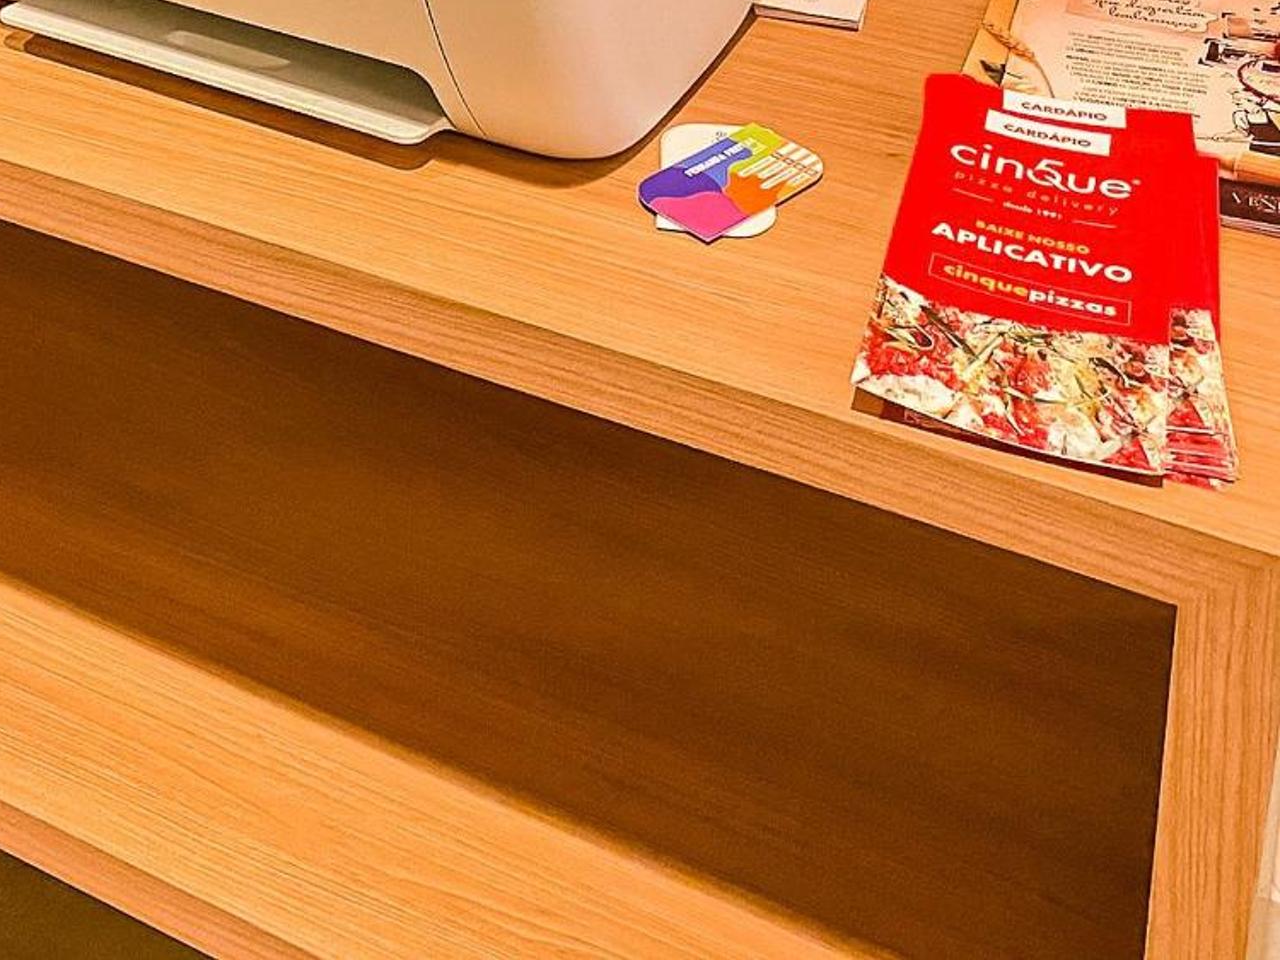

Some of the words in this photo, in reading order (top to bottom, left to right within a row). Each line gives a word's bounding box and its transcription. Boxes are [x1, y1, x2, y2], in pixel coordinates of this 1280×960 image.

[1020, 100, 1108, 121] CARDÁPIO
[1003, 121, 1092, 148] CARDÁPIO
[954, 171, 1013, 193] pizza
[1026, 190, 1119, 217] delivery
[931, 222, 1133, 284] APLICATIVO
[975, 220, 1025, 240] BAIXE
[1028, 235, 1091, 255] NOSSO
[943, 263, 1118, 318] cinquepizzas
